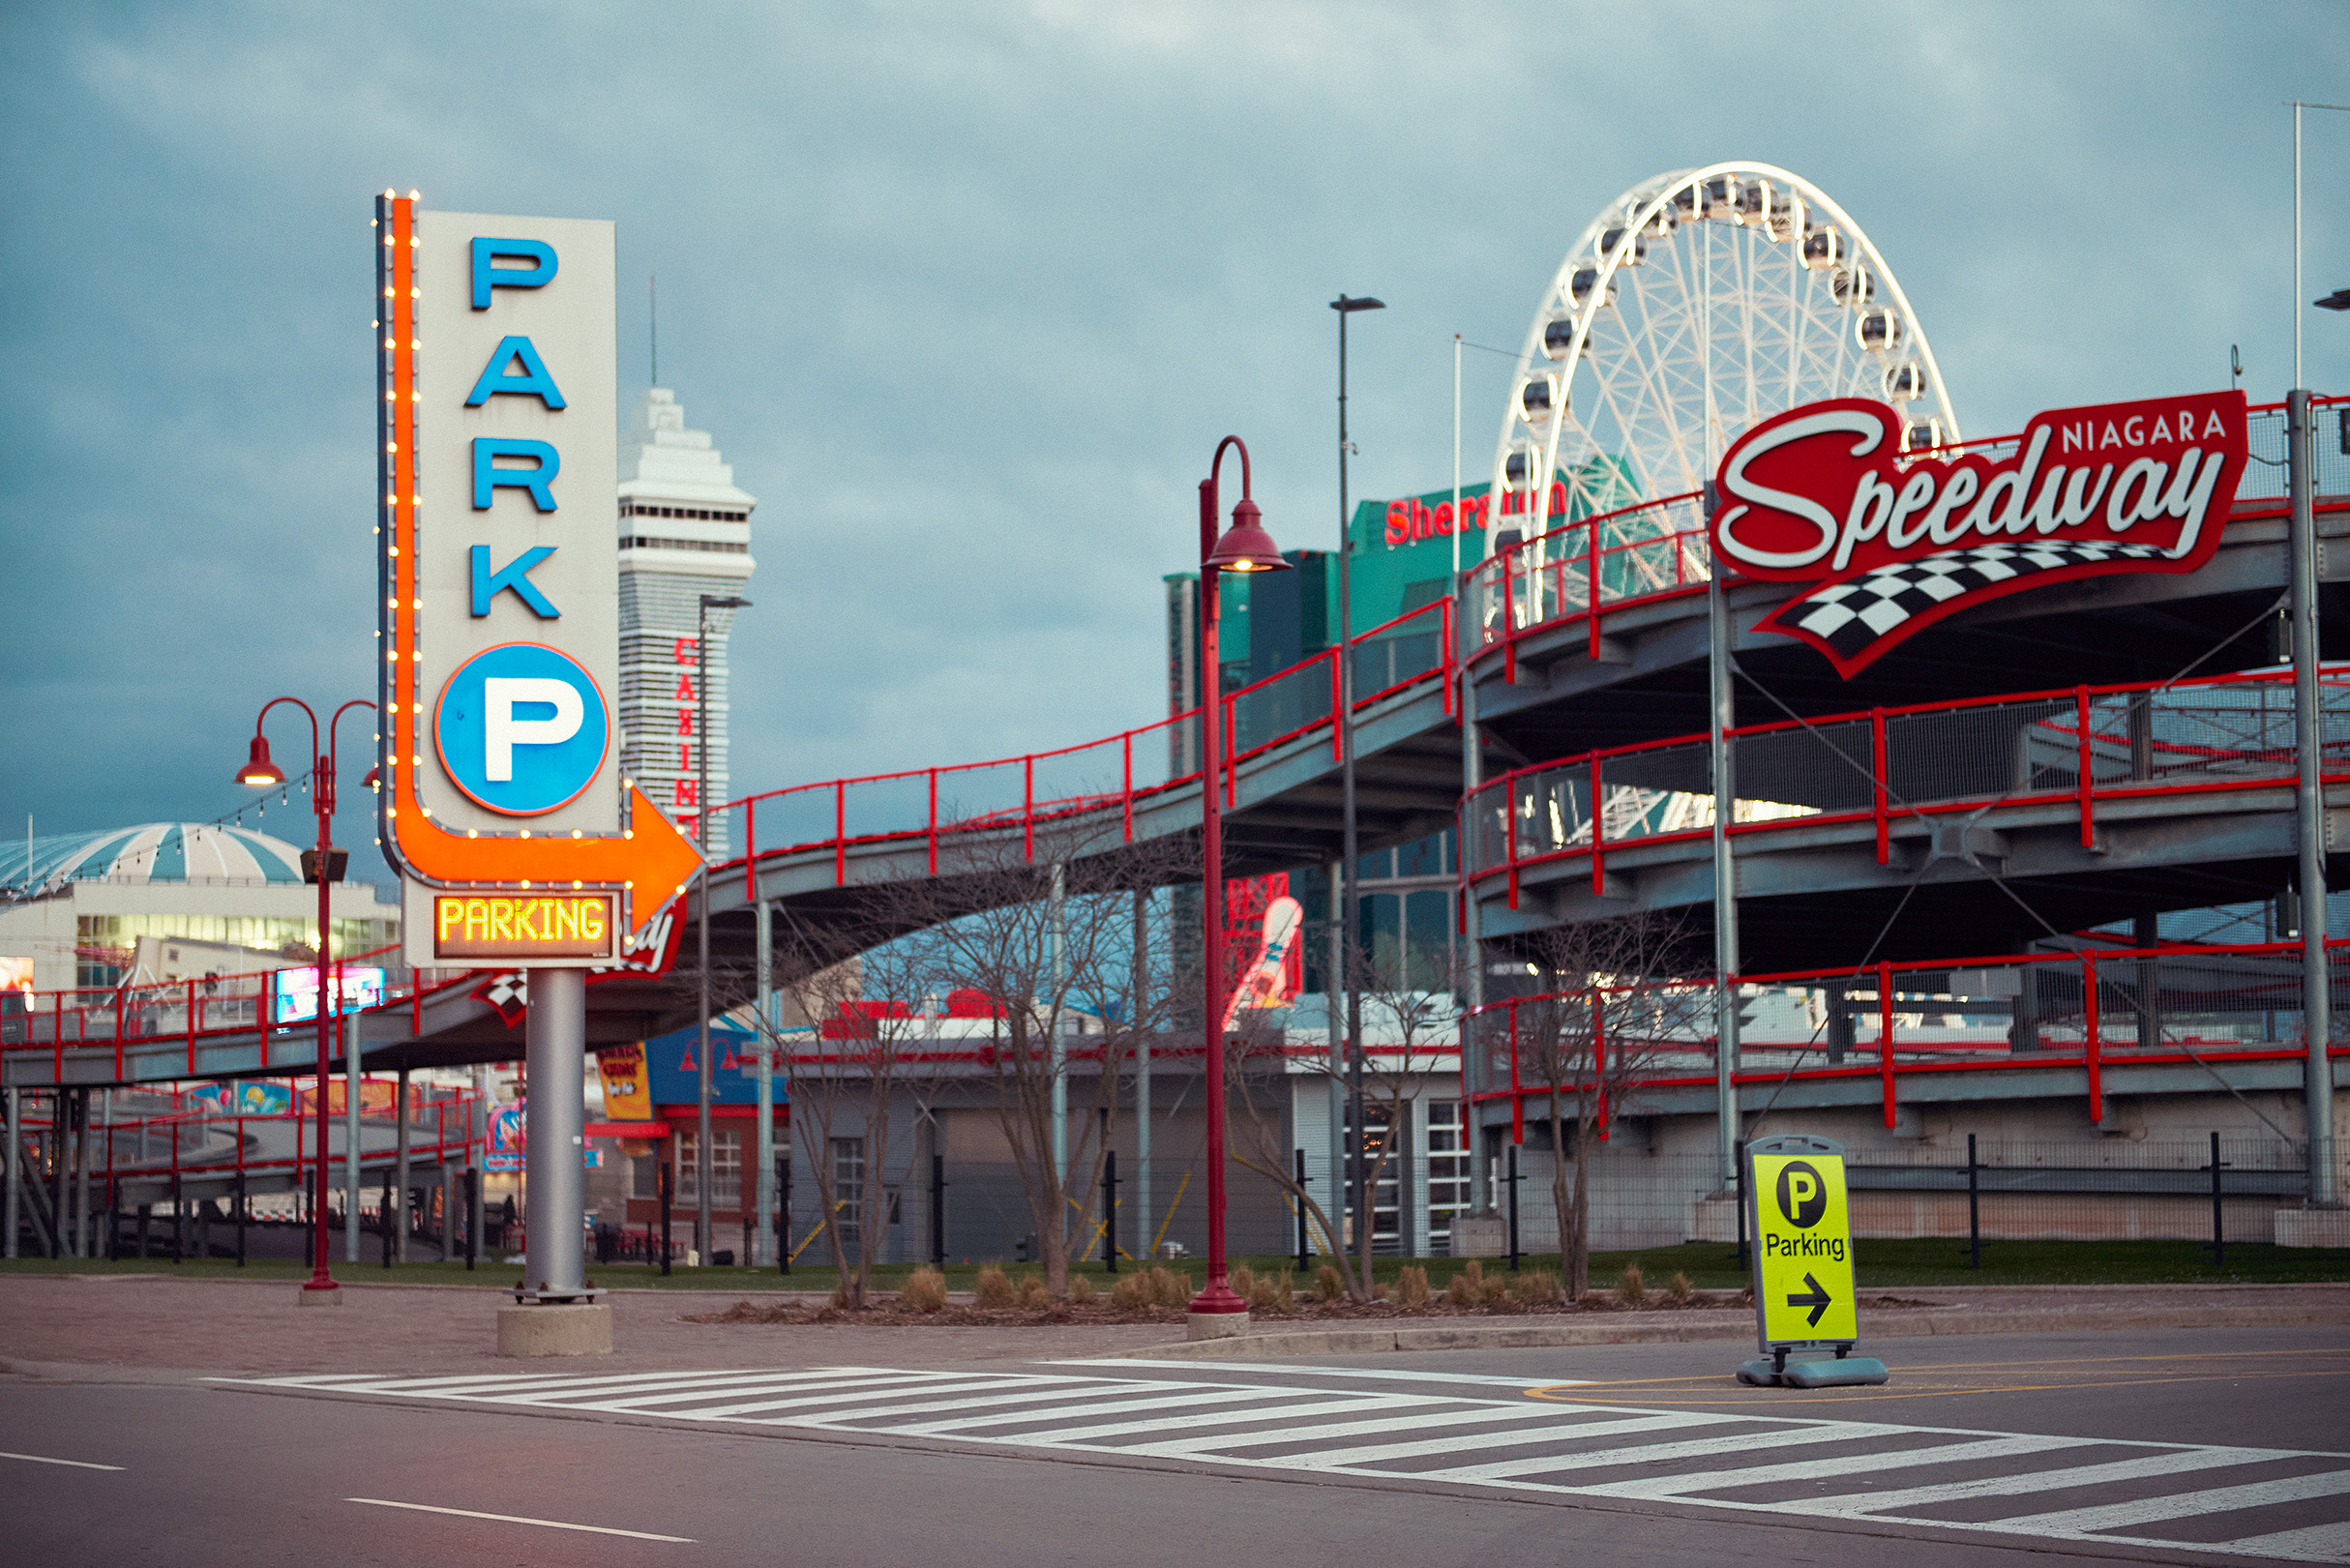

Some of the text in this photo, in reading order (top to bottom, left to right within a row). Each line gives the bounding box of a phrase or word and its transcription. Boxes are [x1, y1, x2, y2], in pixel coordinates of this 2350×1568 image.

[463, 236, 567, 618] PARK
[2062, 408, 2226, 454] NIAGARA
[1384, 481, 1566, 545] Sheraton
[1717, 410, 2224, 571] Speedway
[485, 677, 584, 782] P
[439, 899, 604, 941] PARKING
[1788, 1171, 1817, 1220] P
[1766, 1233, 1845, 1261] Parking
